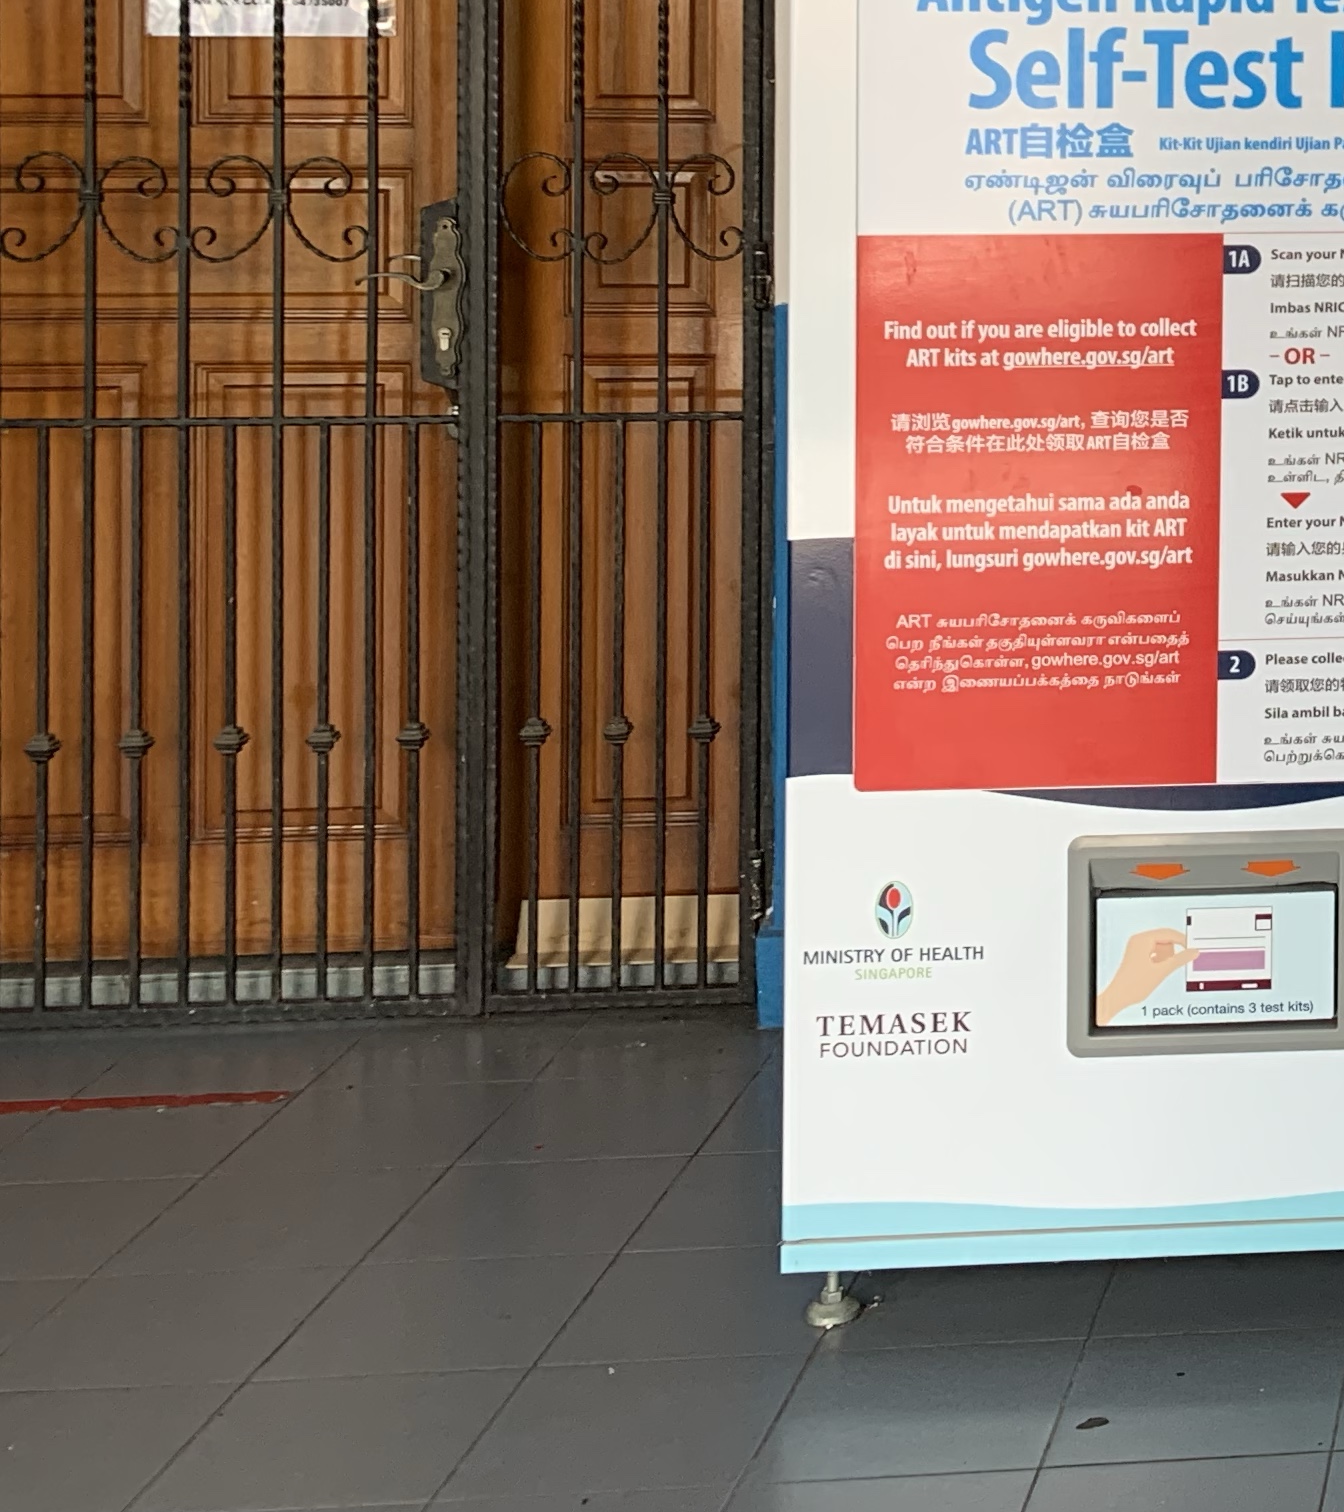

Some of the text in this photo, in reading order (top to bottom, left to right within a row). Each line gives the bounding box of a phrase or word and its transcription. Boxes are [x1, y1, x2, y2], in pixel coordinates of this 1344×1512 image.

[970, 28, 1303, 108] Self-Test
[962, 120, 1138, 161] ART自检盒
[1160, 138, 1202, 150] Kit-Kit
[1206, 138, 1240, 153] Ujian
[1245, 137, 1292, 150] kendiri
[1296, 137, 1330, 153] Ujian
[1229, 249, 1250, 269] 1A
[1272, 249, 1302, 260] Scan
[1306, 252, 1336, 262] your
[885, 317, 1199, 342] Find out if you are eligible to collect
[905, 347, 1175, 371] ART kits at gowhere.gov.sg/art
[1227, 374, 1248, 393] 1B
[1269, 374, 1293, 388] Tap
[1296, 376, 1310, 384] to
[888, 491, 1190, 517] Untuk mengetahui sama ada anda
[890, 518, 1187, 546] layak untuk mendapatkan kit ART
[1267, 518, 1302, 528] Enter
[1306, 519, 1336, 530] your
[1229, 655, 1241, 674] 2
[1266, 654, 1308, 664] Please
[804, 946, 983, 964] MINISTRY OF HEALTH
[855, 967, 932, 980] SINGAPORE
[1142, 1001, 1313, 1018] 1 pack (contains 3 test kits)
[816, 1012, 971, 1036] TEMASEK
[820, 1038, 966, 1058] FOUNDATION
